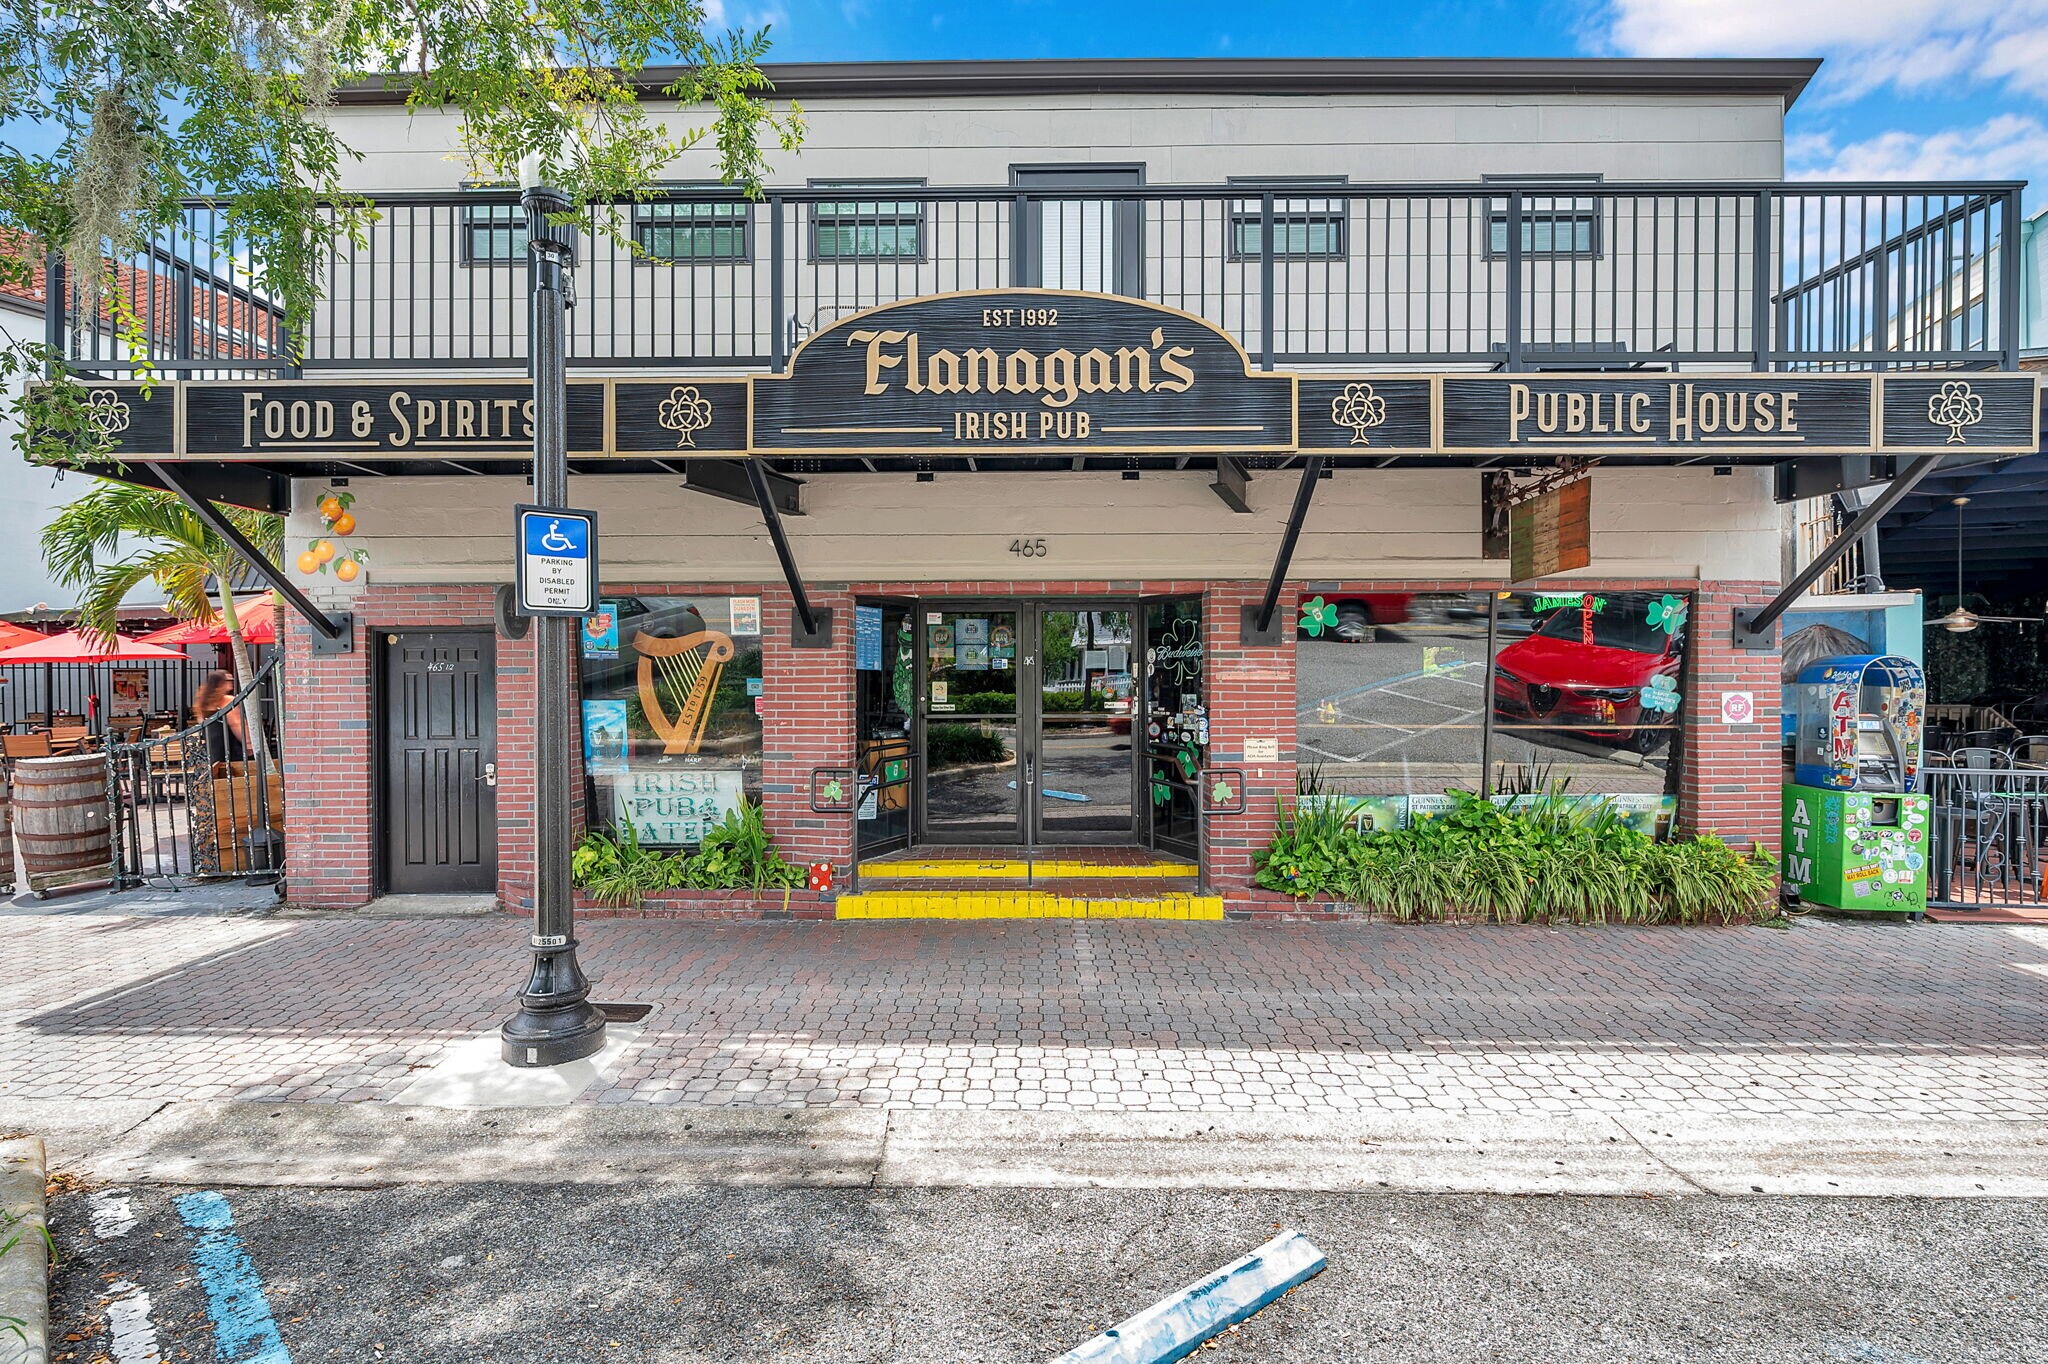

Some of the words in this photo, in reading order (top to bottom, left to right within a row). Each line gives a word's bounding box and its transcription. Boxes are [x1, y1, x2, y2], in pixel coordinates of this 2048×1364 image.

[983, 309, 1014, 327] EST
[1020, 308, 1058, 327] 1992
[847, 326, 1195, 408] Flanagan's
[242, 392, 334, 447] FOOD
[351, 400, 375, 438] &
[1508, 383, 1651, 443] PUBLIC
[1668, 383, 1799, 442] HOUSE
[954, 412, 1028, 440] IRISH
[1039, 411, 1091, 439] PUB
[1009, 539, 1047, 558] 465
[541, 558, 573, 566] PARKING
[539, 577, 575, 585] DISABLED
[544, 587, 570, 595] PERMIT
[547, 597, 568, 605] ONLY
[1583, 594, 1594, 645] OPEN
[427, 662, 444, 672] 465
[693, 676, 708, 699] 1759
[633, 773, 720, 794] IRISH
[1411, 796, 1448, 804] GUINNESS
[1491, 796, 1526, 805] GUINESS
[1399, 797, 1407, 831] UINNESS
[1787, 798, 1812, 884] ATM
